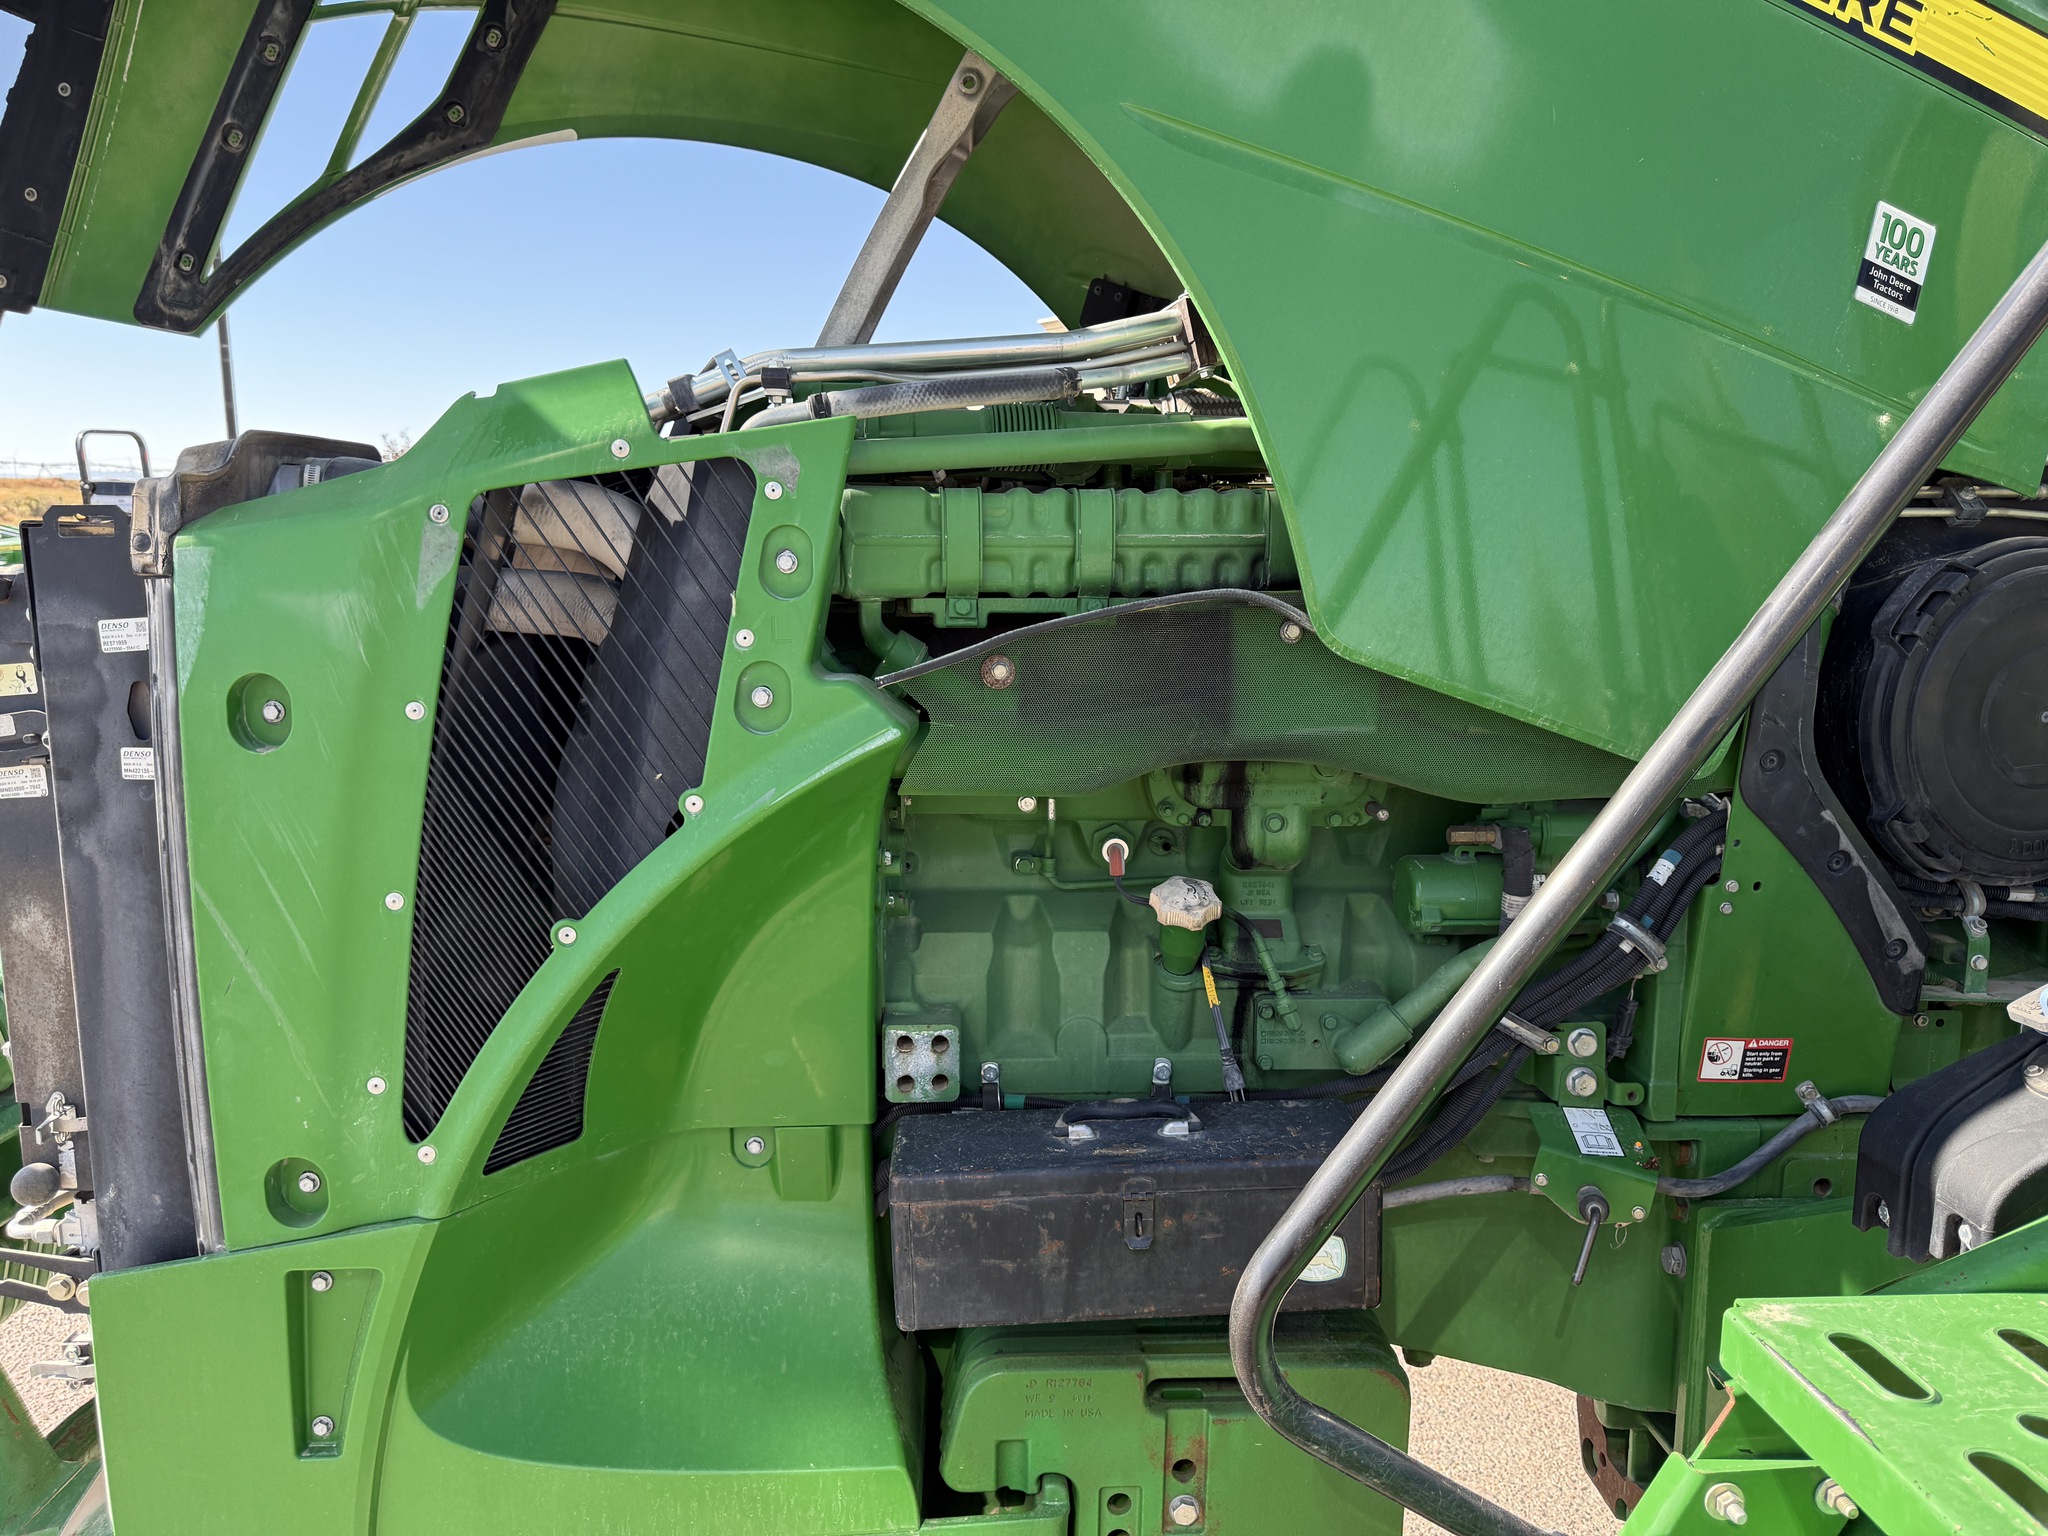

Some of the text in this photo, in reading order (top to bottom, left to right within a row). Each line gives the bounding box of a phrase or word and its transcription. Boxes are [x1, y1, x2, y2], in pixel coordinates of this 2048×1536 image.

[1881, 211, 1925, 259] 100
[1875, 242, 1918, 277] YEARS
[1869, 266, 1911, 294] John Deere
[1873, 279, 1904, 301] Tractors
[1870, 296, 1899, 314] SINCE 1918
[101, 622, 129, 630] DENSO
[123, 750, 152, 758] DENSO
[1758, 1039, 1790, 1047] DANGER
[1024, 1408, 1102, 1419] MADE IN USA
